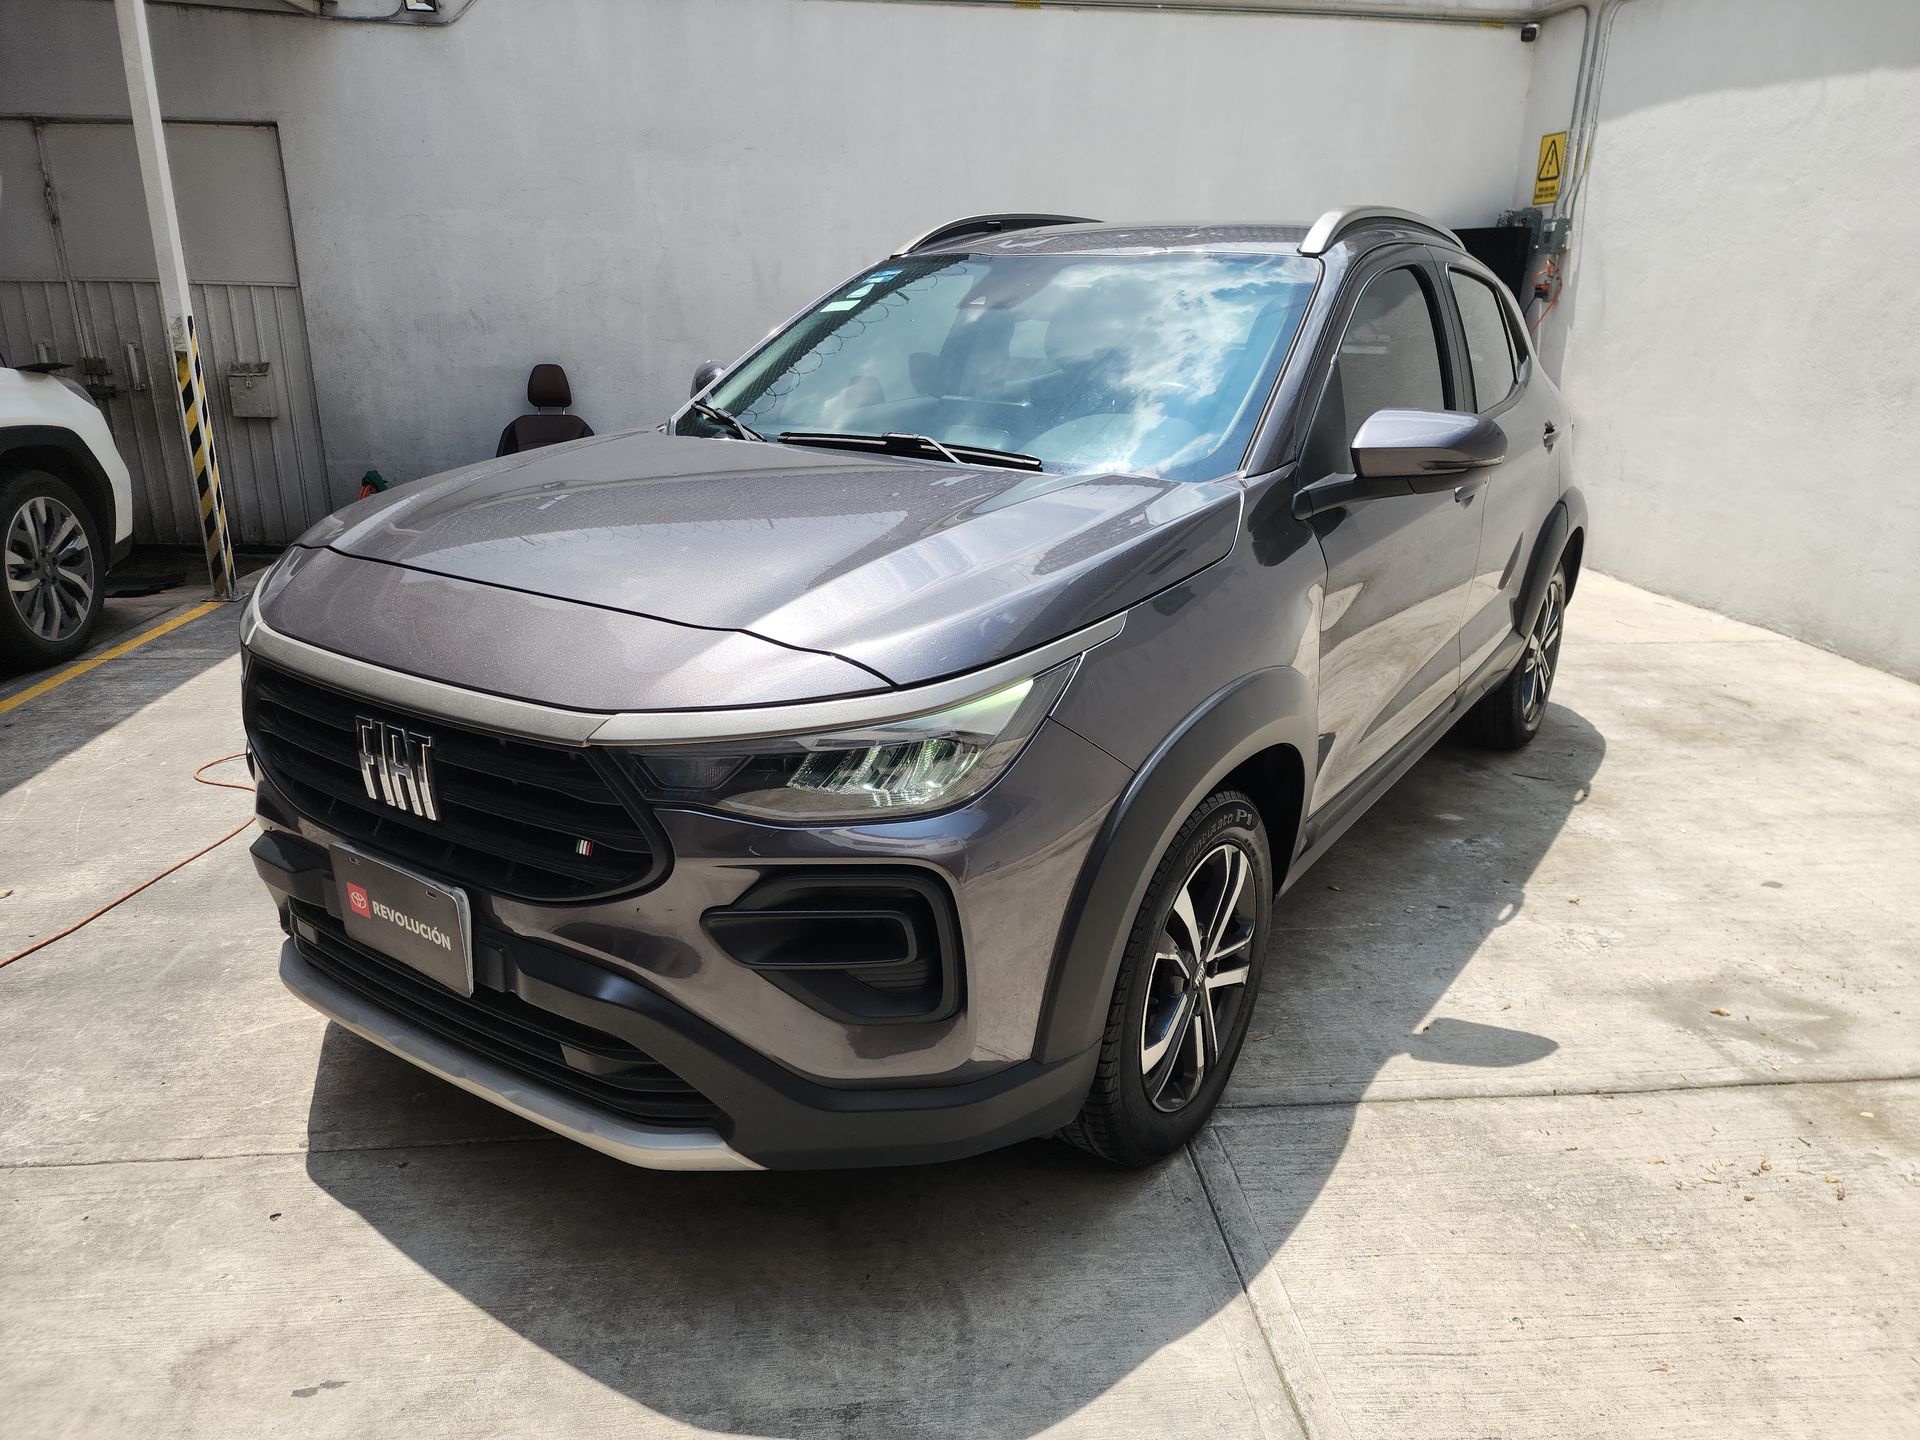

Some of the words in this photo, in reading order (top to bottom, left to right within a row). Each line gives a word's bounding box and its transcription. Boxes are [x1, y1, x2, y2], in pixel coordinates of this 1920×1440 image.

[355, 715, 438, 821] FIAT
[372, 900, 452, 951] REVOLUCIÓN
[1195, 961, 1206, 988] FIAT
